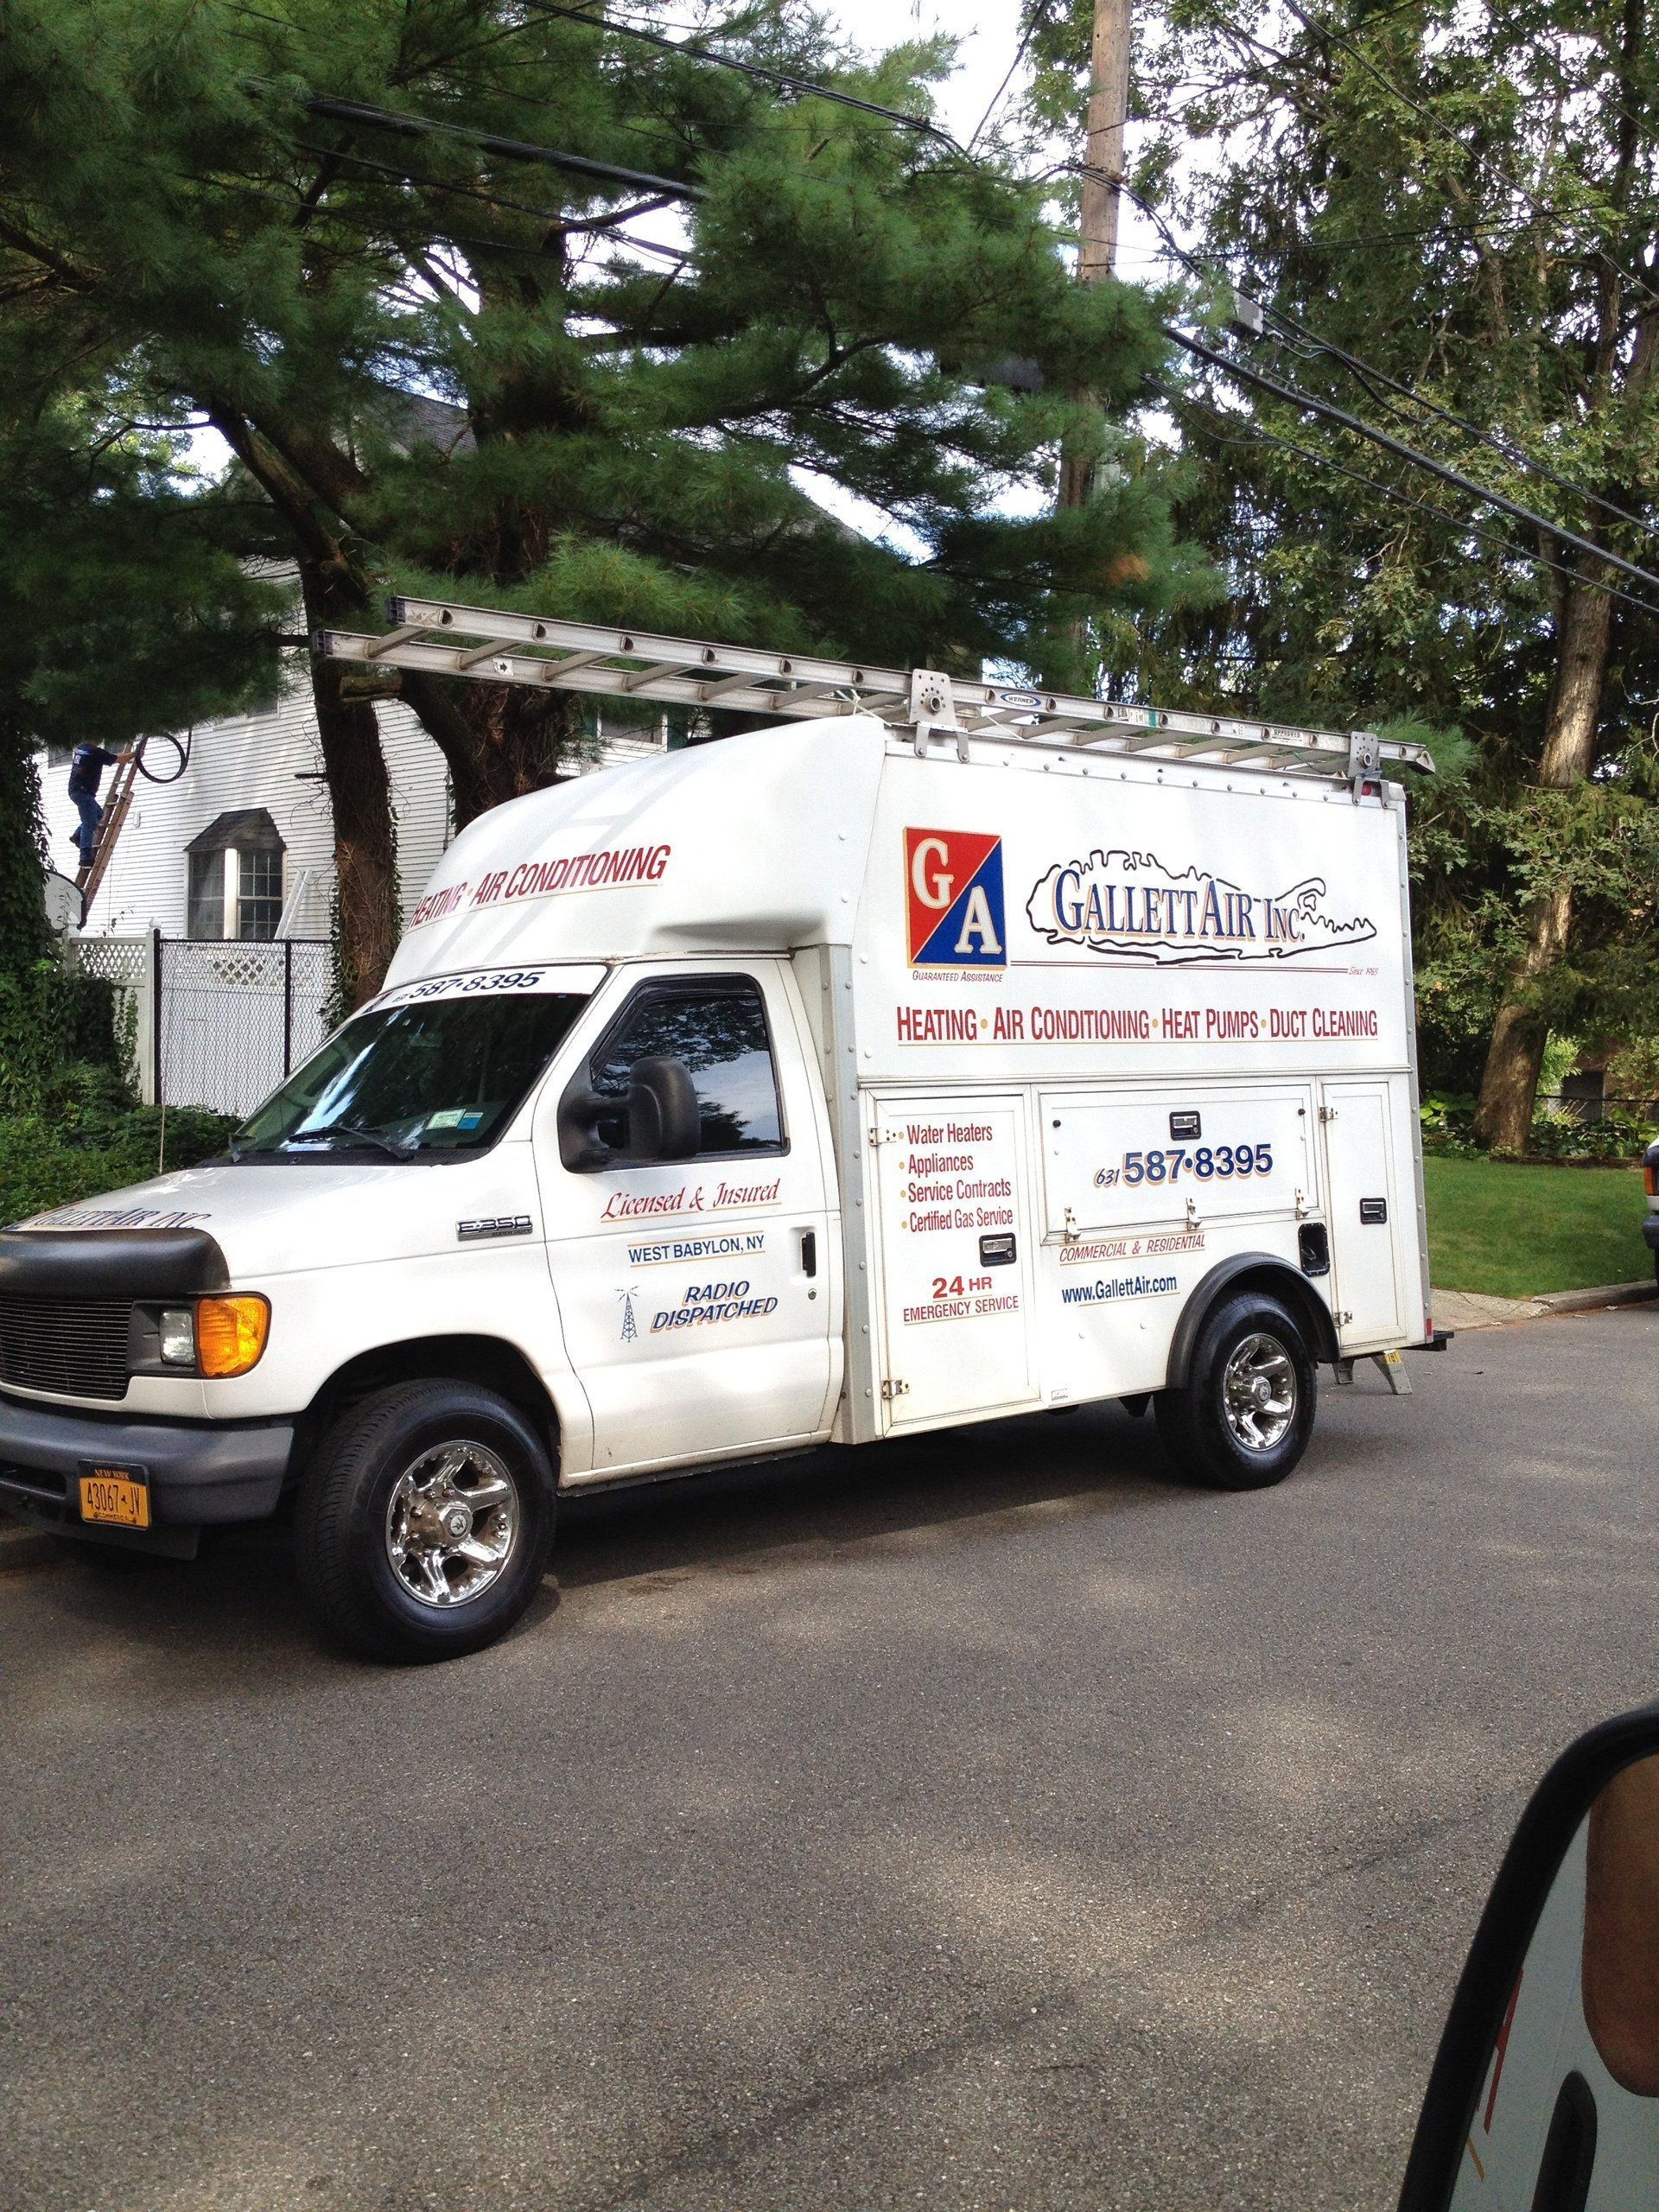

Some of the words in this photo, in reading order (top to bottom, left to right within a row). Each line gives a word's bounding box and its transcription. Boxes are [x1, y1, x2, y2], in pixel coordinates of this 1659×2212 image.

[1007, 695, 1034, 704] WERNER
[407, 881, 468, 929] HEATING
[468, 869, 509, 906] AIR
[504, 844, 671, 899] CONDITIONING
[1262, 898, 1306, 942] INC.
[912, 969, 959, 982] GUARANTEED
[960, 971, 1003, 982] ASSISTANCE
[897, 1007, 977, 1040] HEATING
[994, 1007, 1024, 1040] AIR
[1031, 1007, 1150, 1039] CONDITIONING
[1162, 1007, 1200, 1039] HEAT
[1206, 1008, 1259, 1039] PUMPS
[1270, 1008, 1307, 1038] DUCT
[1313, 1007, 1378, 1037] CLEANING
[906, 1124, 944, 1145] Water
[947, 1122, 993, 1142] Heaters
[908, 1153, 974, 1179] Appliances
[1094, 1167, 1121, 1187] 631
[601, 1187, 686, 1220] Licensed
[689, 1186, 706, 1211] &
[712, 1178, 782, 1209] Insured
[908, 1180, 953, 1203] Service
[956, 1178, 1011, 1199] Contracts
[910, 1210, 952, 1232] Certified
[955, 1209, 975, 1229] Gas
[976, 1206, 1014, 1227] Service
[628, 1244, 671, 1263] WEST
[673, 1237, 744, 1259] BABYLON,
[747, 1235, 765, 1249] NY
[1059, 1242, 1128, 1262] COMMERCIAL
[1132, 1244, 1141, 1255] &
[1146, 1234, 1205, 1254] RESIDENTIAL
[683, 1281, 750, 1306] RADIO
[931, 1275, 965, 1299] 24
[969, 1276, 993, 1291] HR
[1062, 1275, 1178, 1304] www.GallettAir.com
[650, 1296, 779, 1334] DISPATCHED
[903, 1301, 971, 1322] EMERGENCY
[975, 1295, 1019, 1313] SERVICE
[94, 1469, 111, 1478] NEW
[111, 1470, 130, 1480] YORK
